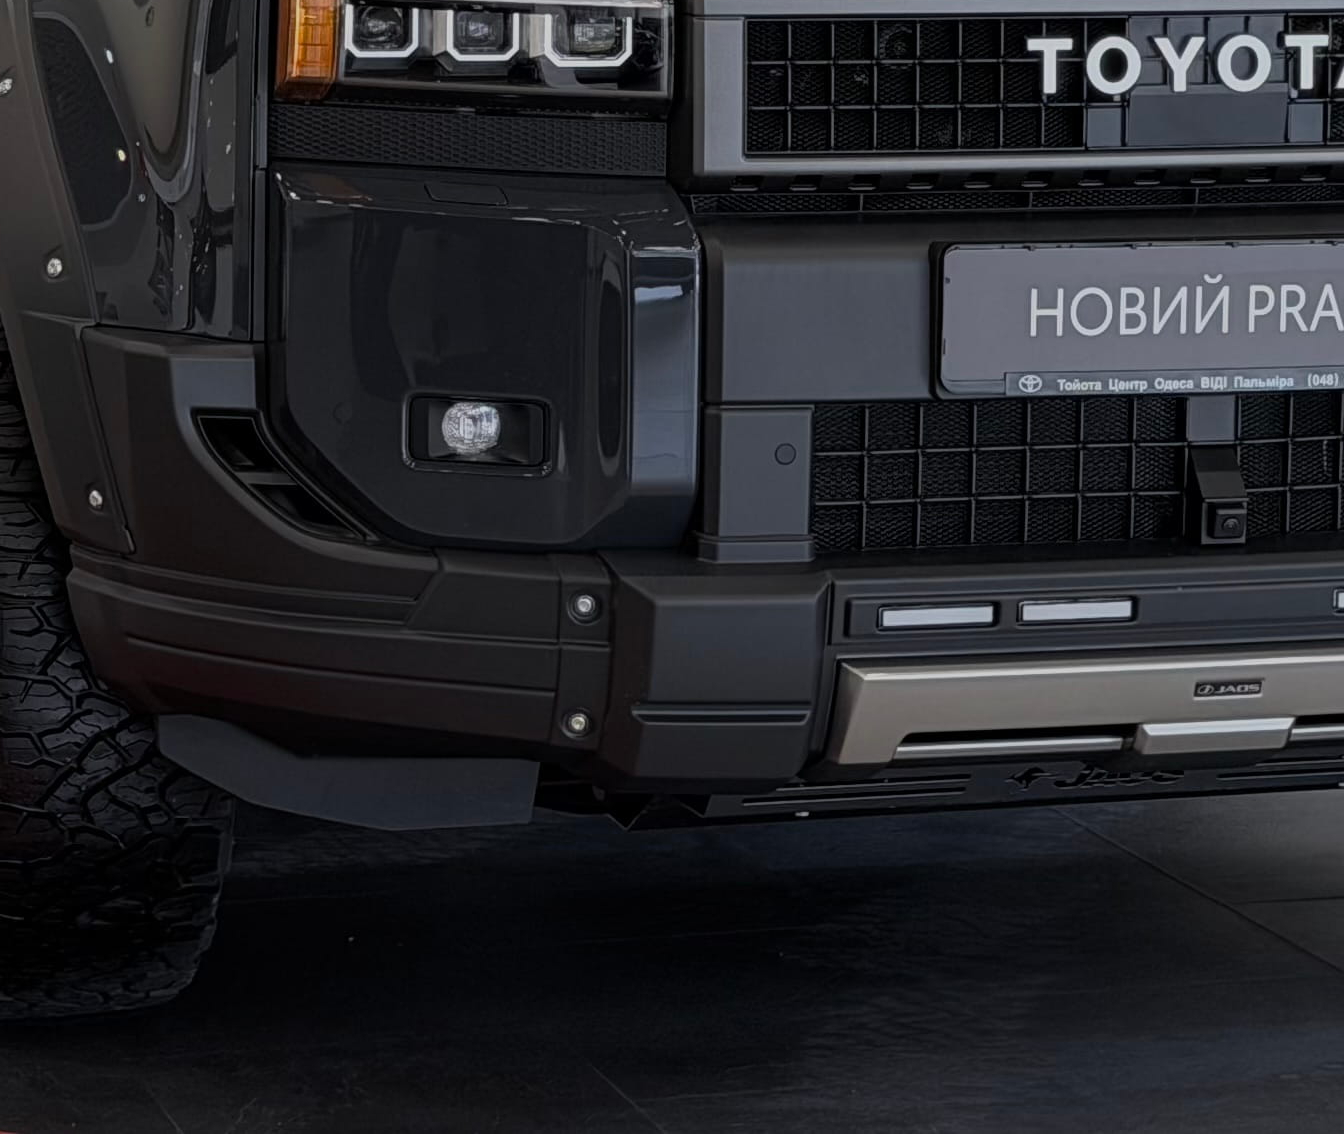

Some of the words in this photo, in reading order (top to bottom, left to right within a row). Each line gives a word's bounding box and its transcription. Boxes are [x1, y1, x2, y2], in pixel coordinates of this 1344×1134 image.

[1029, 273, 1230, 337] НОВИЙ
[1057, 377, 1102, 392] Тойота
[1109, 377, 1147, 393] Центр
[1154, 377, 1194, 391] Одеса
[1200, 375, 1227, 392] ВІДІ
[1234, 374, 1294, 390] Пальміра
[1307, 372, 1338, 388] (048)
[1214, 682, 1261, 695] JAOS
